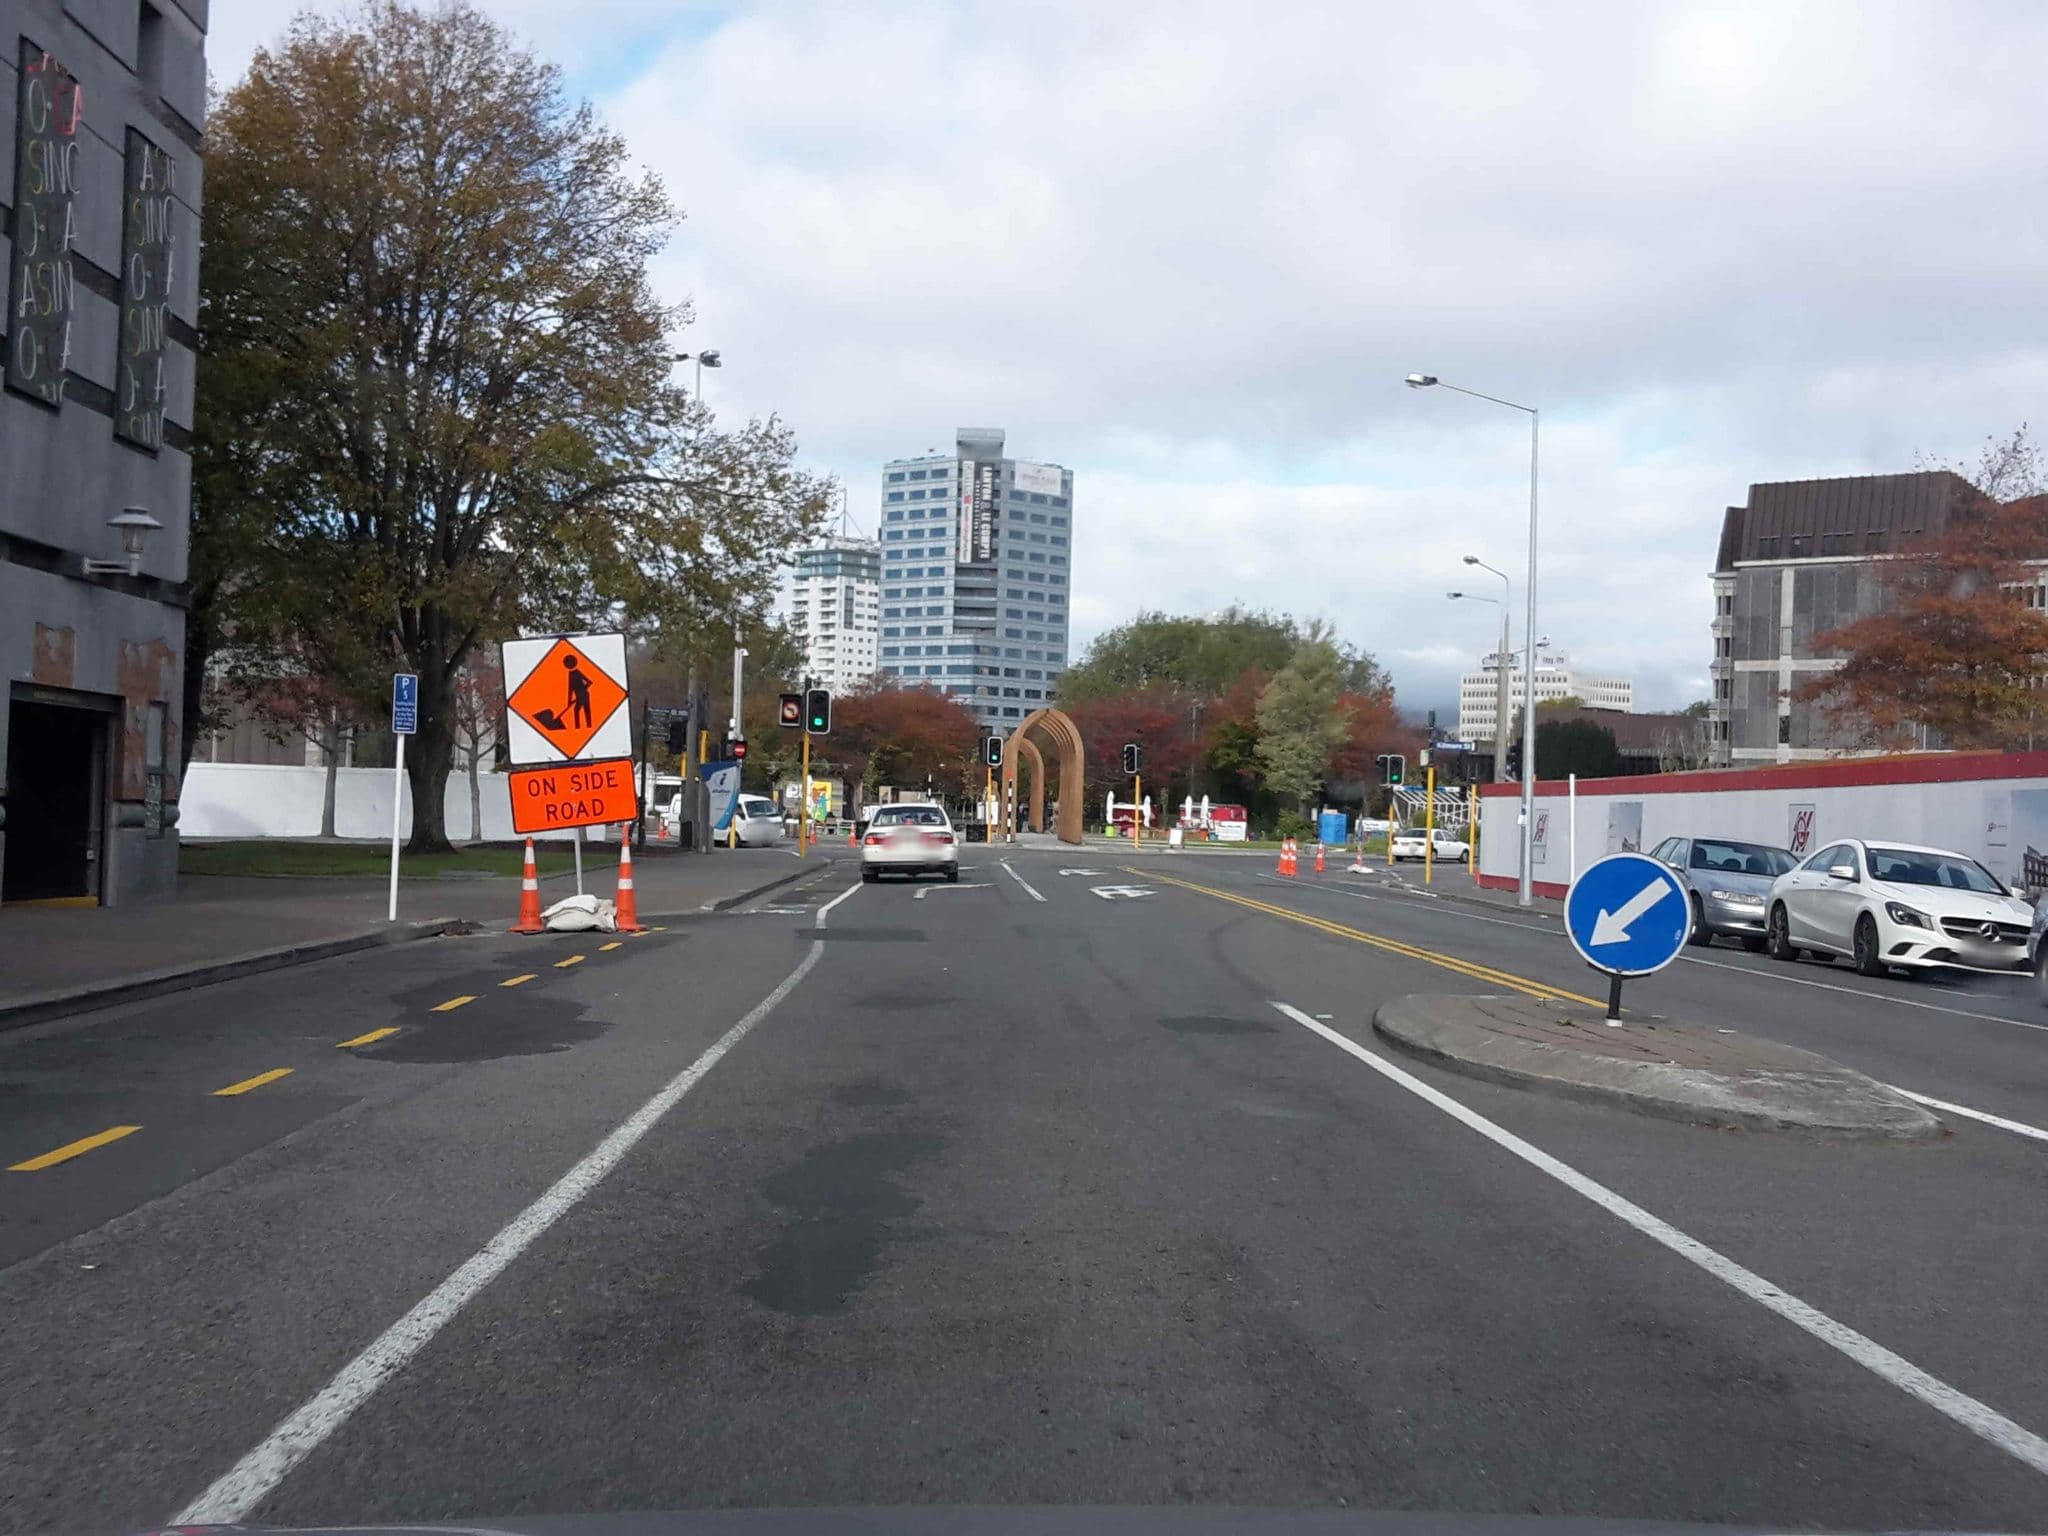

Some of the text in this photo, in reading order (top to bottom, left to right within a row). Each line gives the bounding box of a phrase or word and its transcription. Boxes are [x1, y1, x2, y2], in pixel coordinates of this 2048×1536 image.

[401, 677, 410, 689] P
[527, 769, 619, 797] ON SIDE
[545, 798, 605, 823] ROAD
